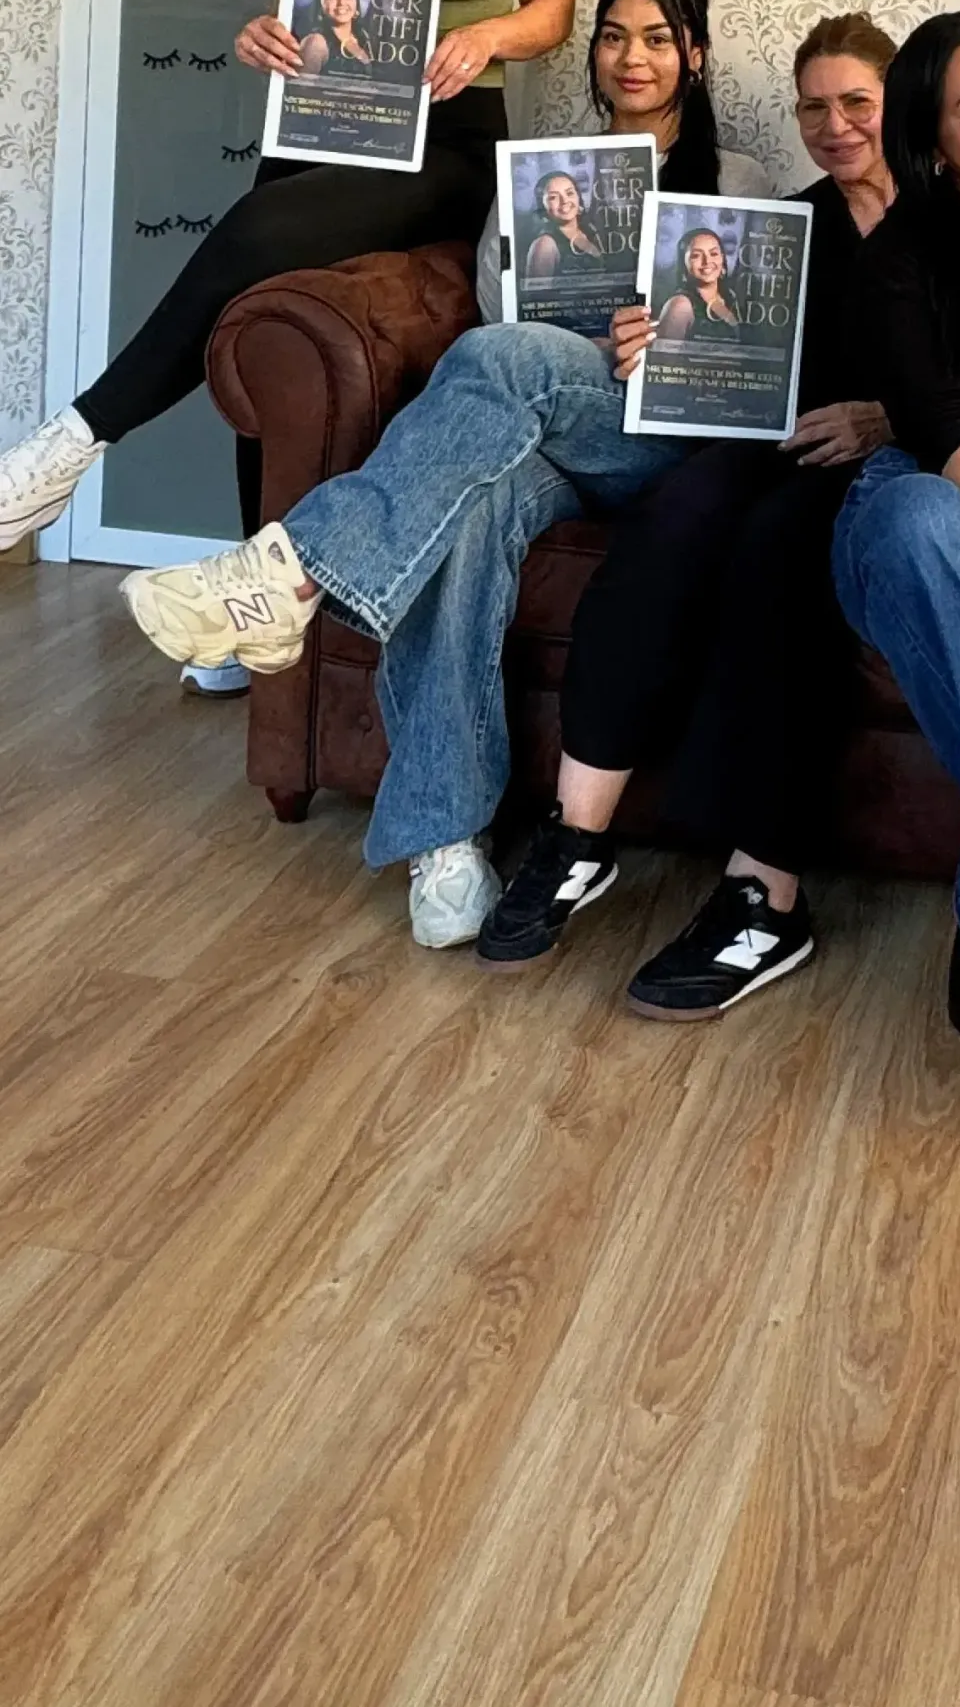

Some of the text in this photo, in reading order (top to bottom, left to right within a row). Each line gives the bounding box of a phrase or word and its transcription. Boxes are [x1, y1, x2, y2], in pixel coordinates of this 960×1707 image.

[373, 14, 423, 42] TIFI
[593, 177, 643, 201] CER
[596, 204, 642, 228] TIF
[739, 243, 794, 272] CER
[739, 272, 793, 300] TIFI
